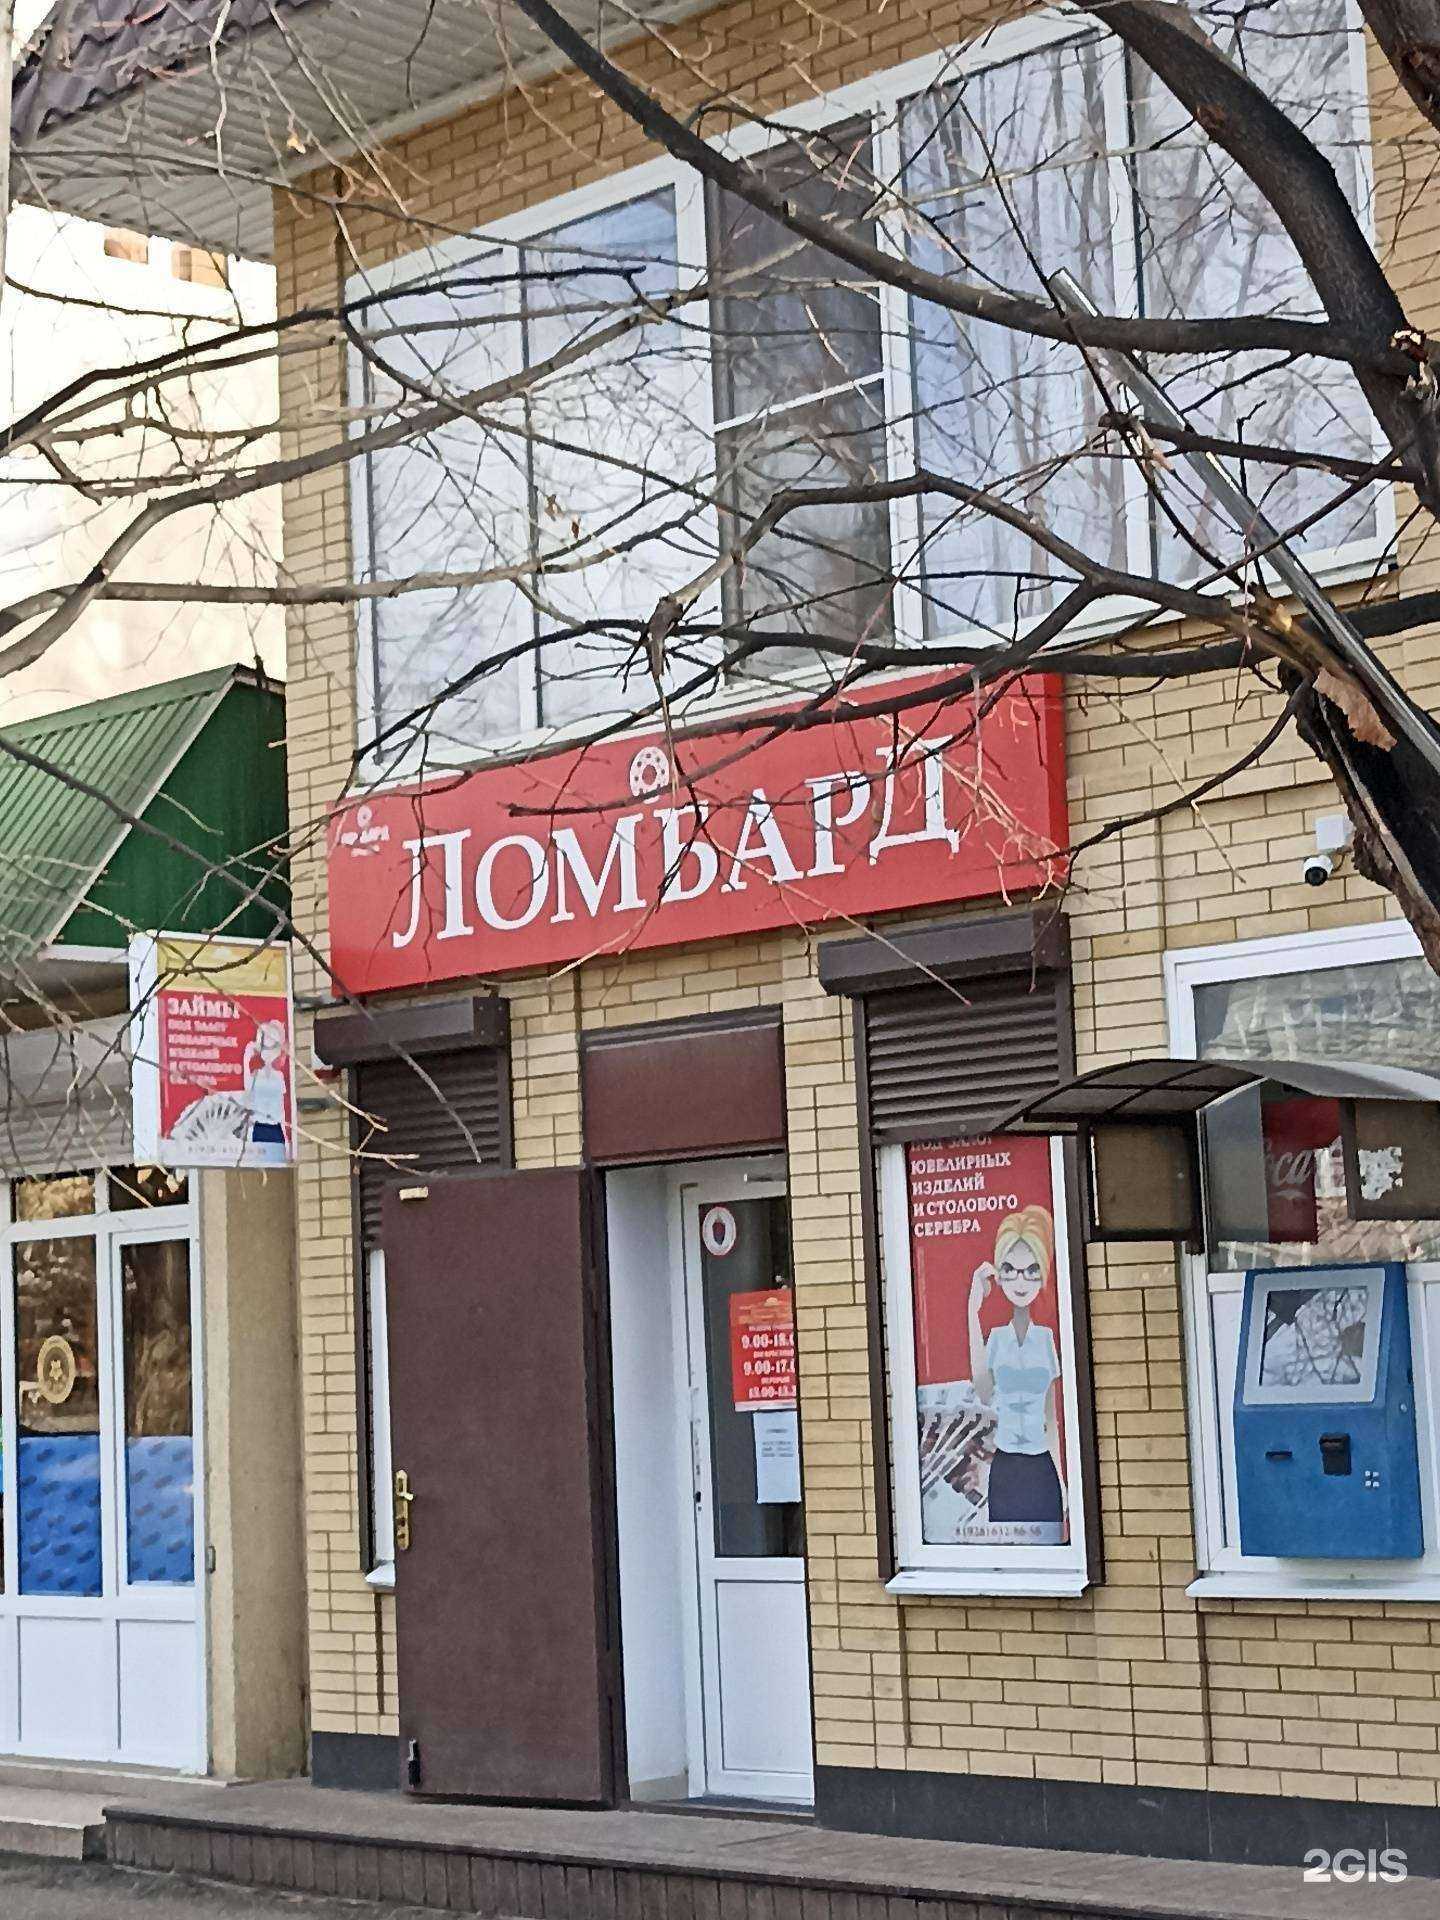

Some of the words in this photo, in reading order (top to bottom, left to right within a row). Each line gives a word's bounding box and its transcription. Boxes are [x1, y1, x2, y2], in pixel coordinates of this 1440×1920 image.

[392, 735, 960, 949] ЛОМБАРД
[167, 994, 241, 1020] ЗАЙМЫ
[911, 1152, 1012, 1176] ЮВЕЛИРНЫХ
[912, 1172, 986, 1197] ИЗДЕЛИЙ
[927, 1194, 1019, 1217] СТОЛОВОГО
[913, 1218, 982, 1239] СЕРЕБРА
